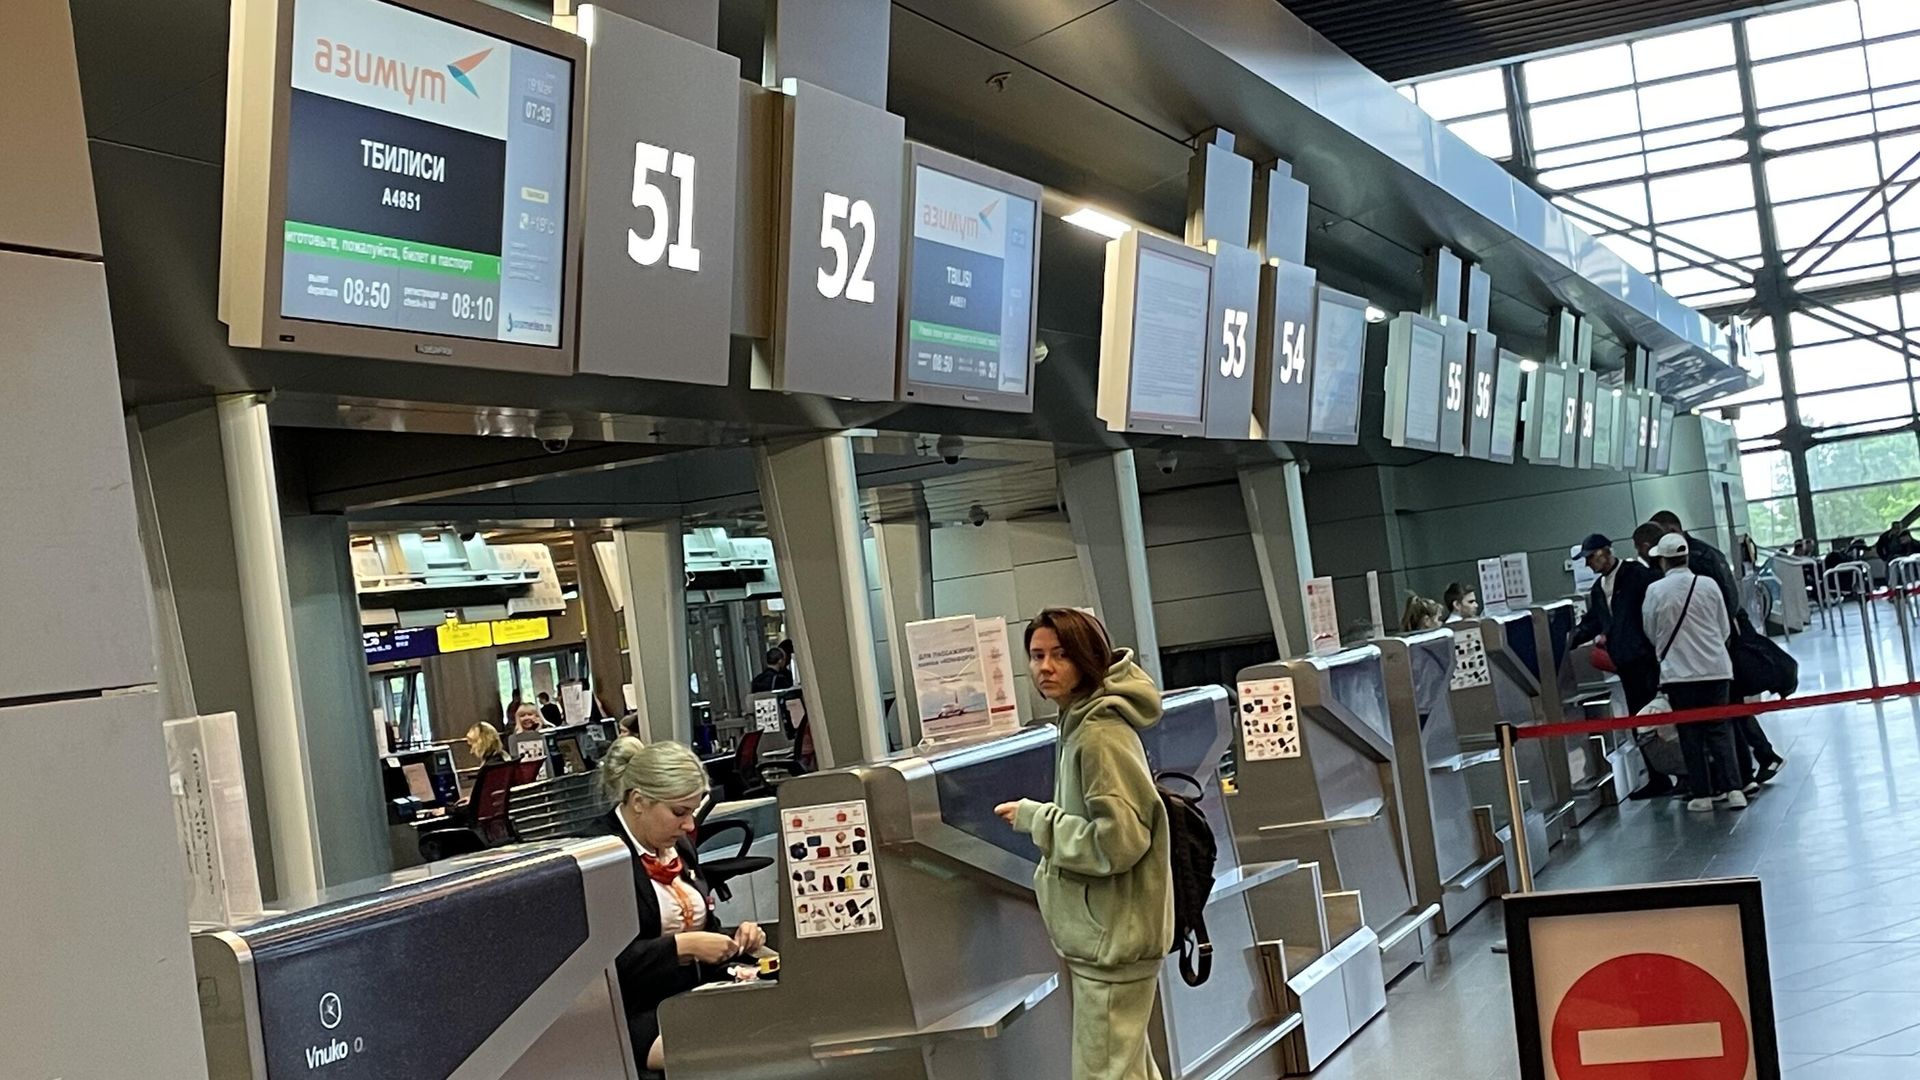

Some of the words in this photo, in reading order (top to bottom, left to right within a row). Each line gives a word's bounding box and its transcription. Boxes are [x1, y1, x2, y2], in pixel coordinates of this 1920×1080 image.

[315, 38, 446, 105] азимут
[525, 101, 552, 123] 07:39
[360, 138, 445, 183] ТБИЛИСИ
[628, 141, 700, 272] 51
[817, 192, 876, 304] 52
[343, 277, 391, 309] 08:50
[452, 292, 493, 322] 08:10
[1220, 308, 1248, 379] 53
[1280, 321, 1306, 384] 54
[1446, 362, 1462, 411] 55
[1475, 371, 1491, 419] 56
[1564, 397, 1576, 435] 57
